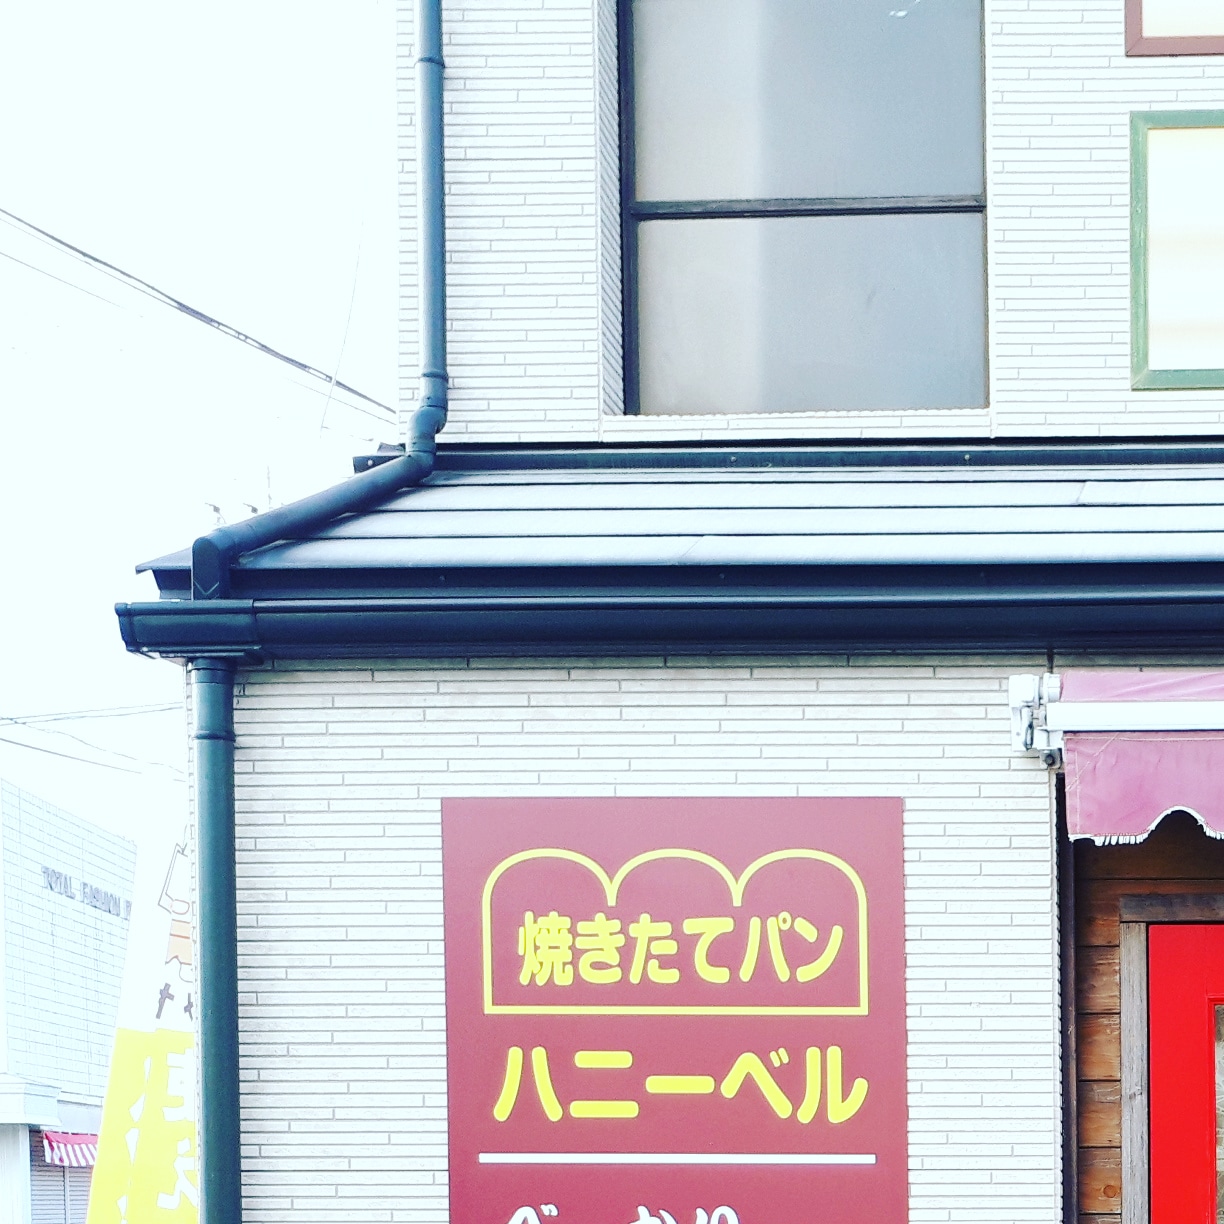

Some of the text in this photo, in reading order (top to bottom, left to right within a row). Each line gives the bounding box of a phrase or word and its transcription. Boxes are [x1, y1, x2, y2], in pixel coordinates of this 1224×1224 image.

[517, 910, 844, 986] 焼きたてパン
[493, 1045, 869, 1124] ハニーベル
